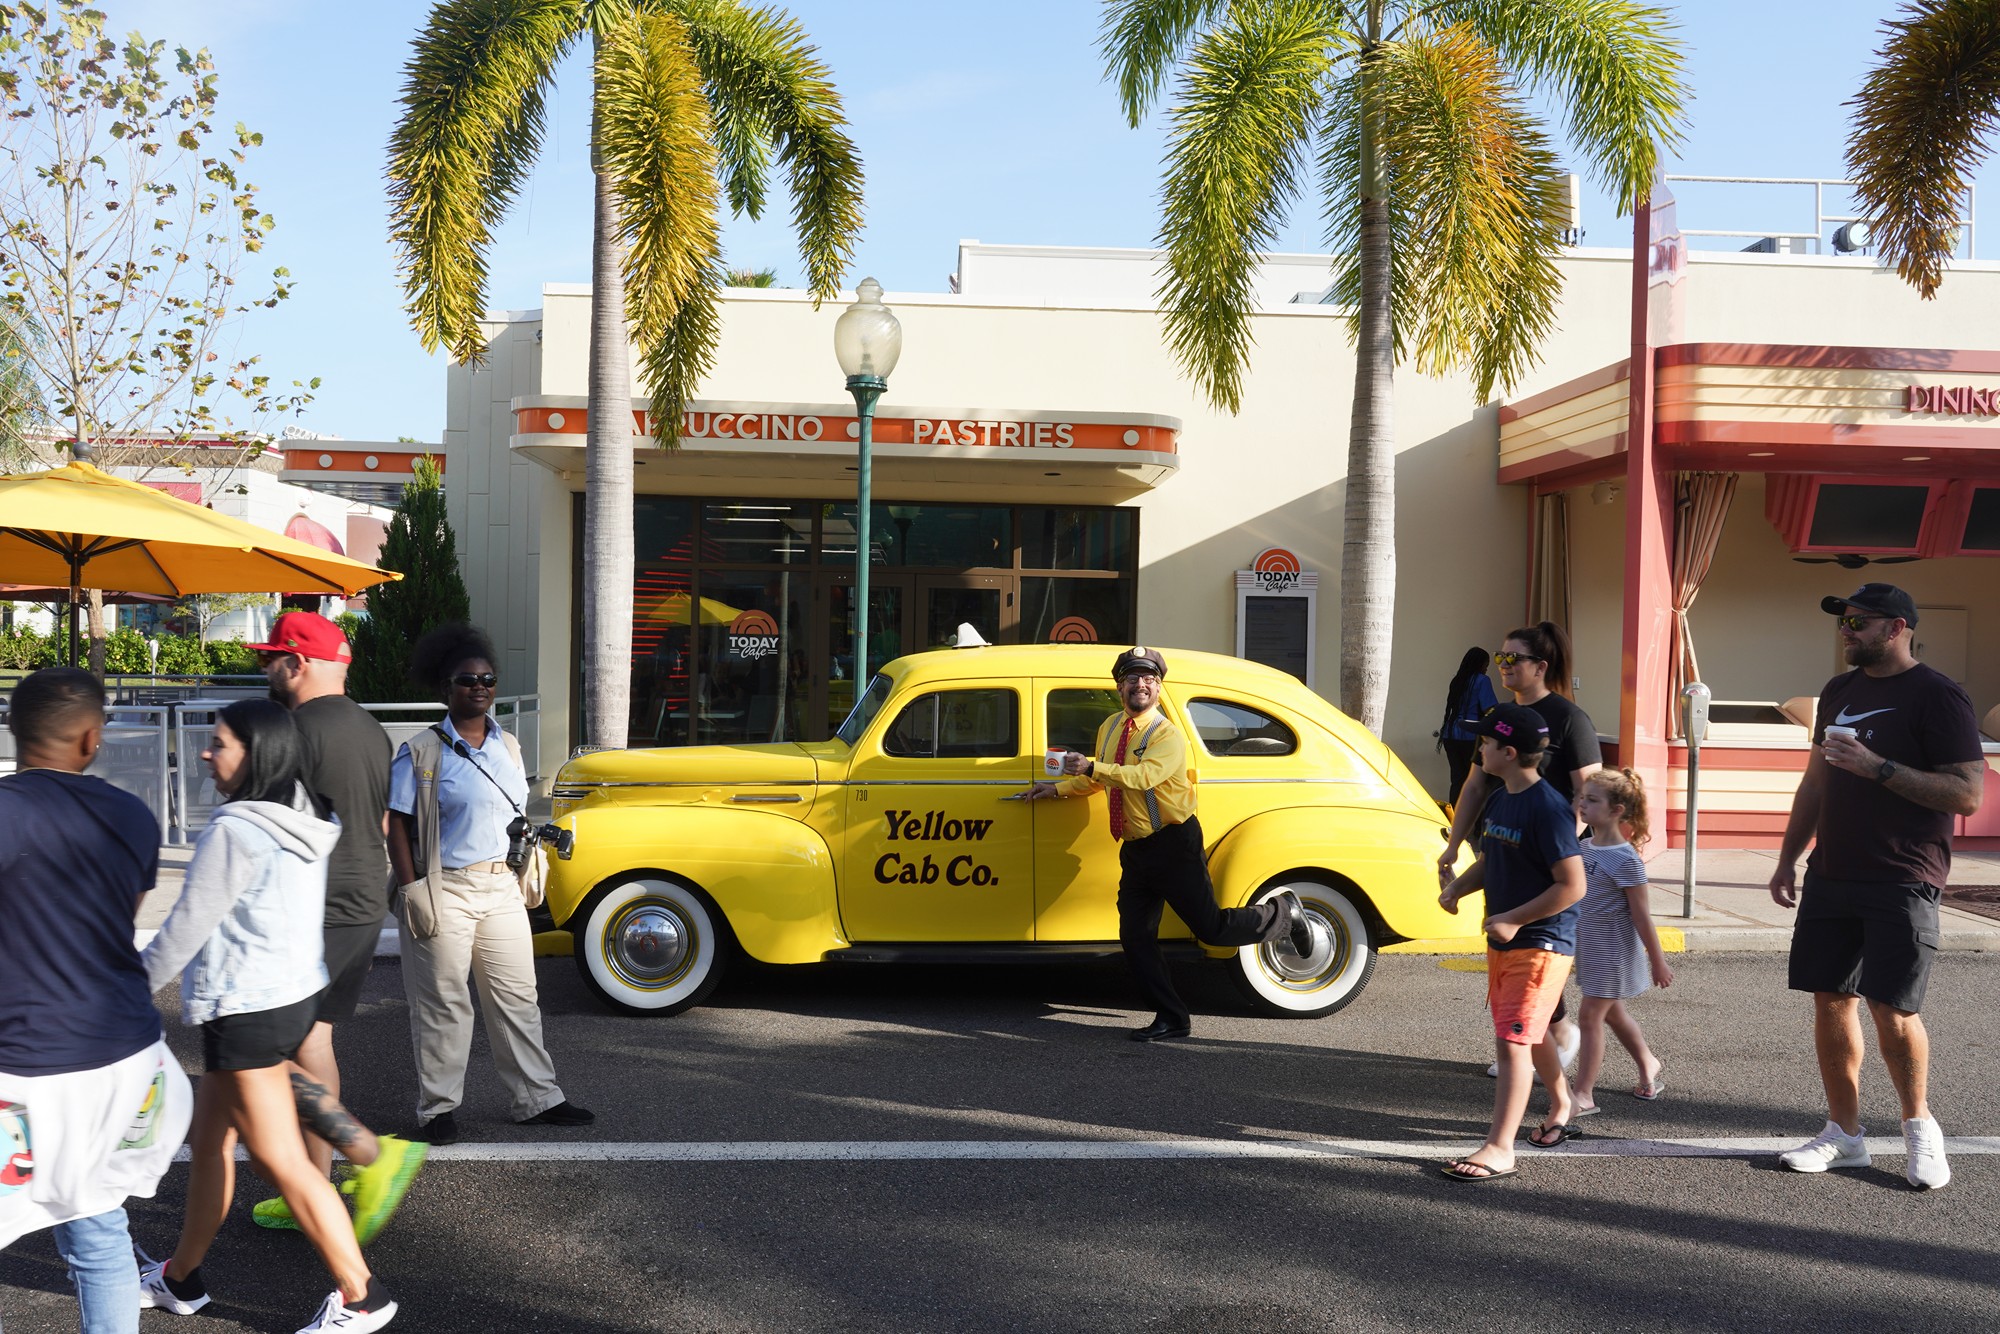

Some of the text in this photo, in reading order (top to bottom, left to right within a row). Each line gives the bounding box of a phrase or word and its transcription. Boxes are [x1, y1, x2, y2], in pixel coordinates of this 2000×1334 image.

[913, 419, 1075, 448] PASTRIES
[1255, 571, 1300, 583] TODAY
[1265, 580, 1289, 593] Cafe
[729, 636, 779, 649] TODAY
[740, 646, 767, 660] Cafe
[1856, 729, 1874, 740] IR
[855, 789, 868, 802] 730
[884, 809, 994, 841] Yellow
[874, 852, 999, 886] Cab Co.
